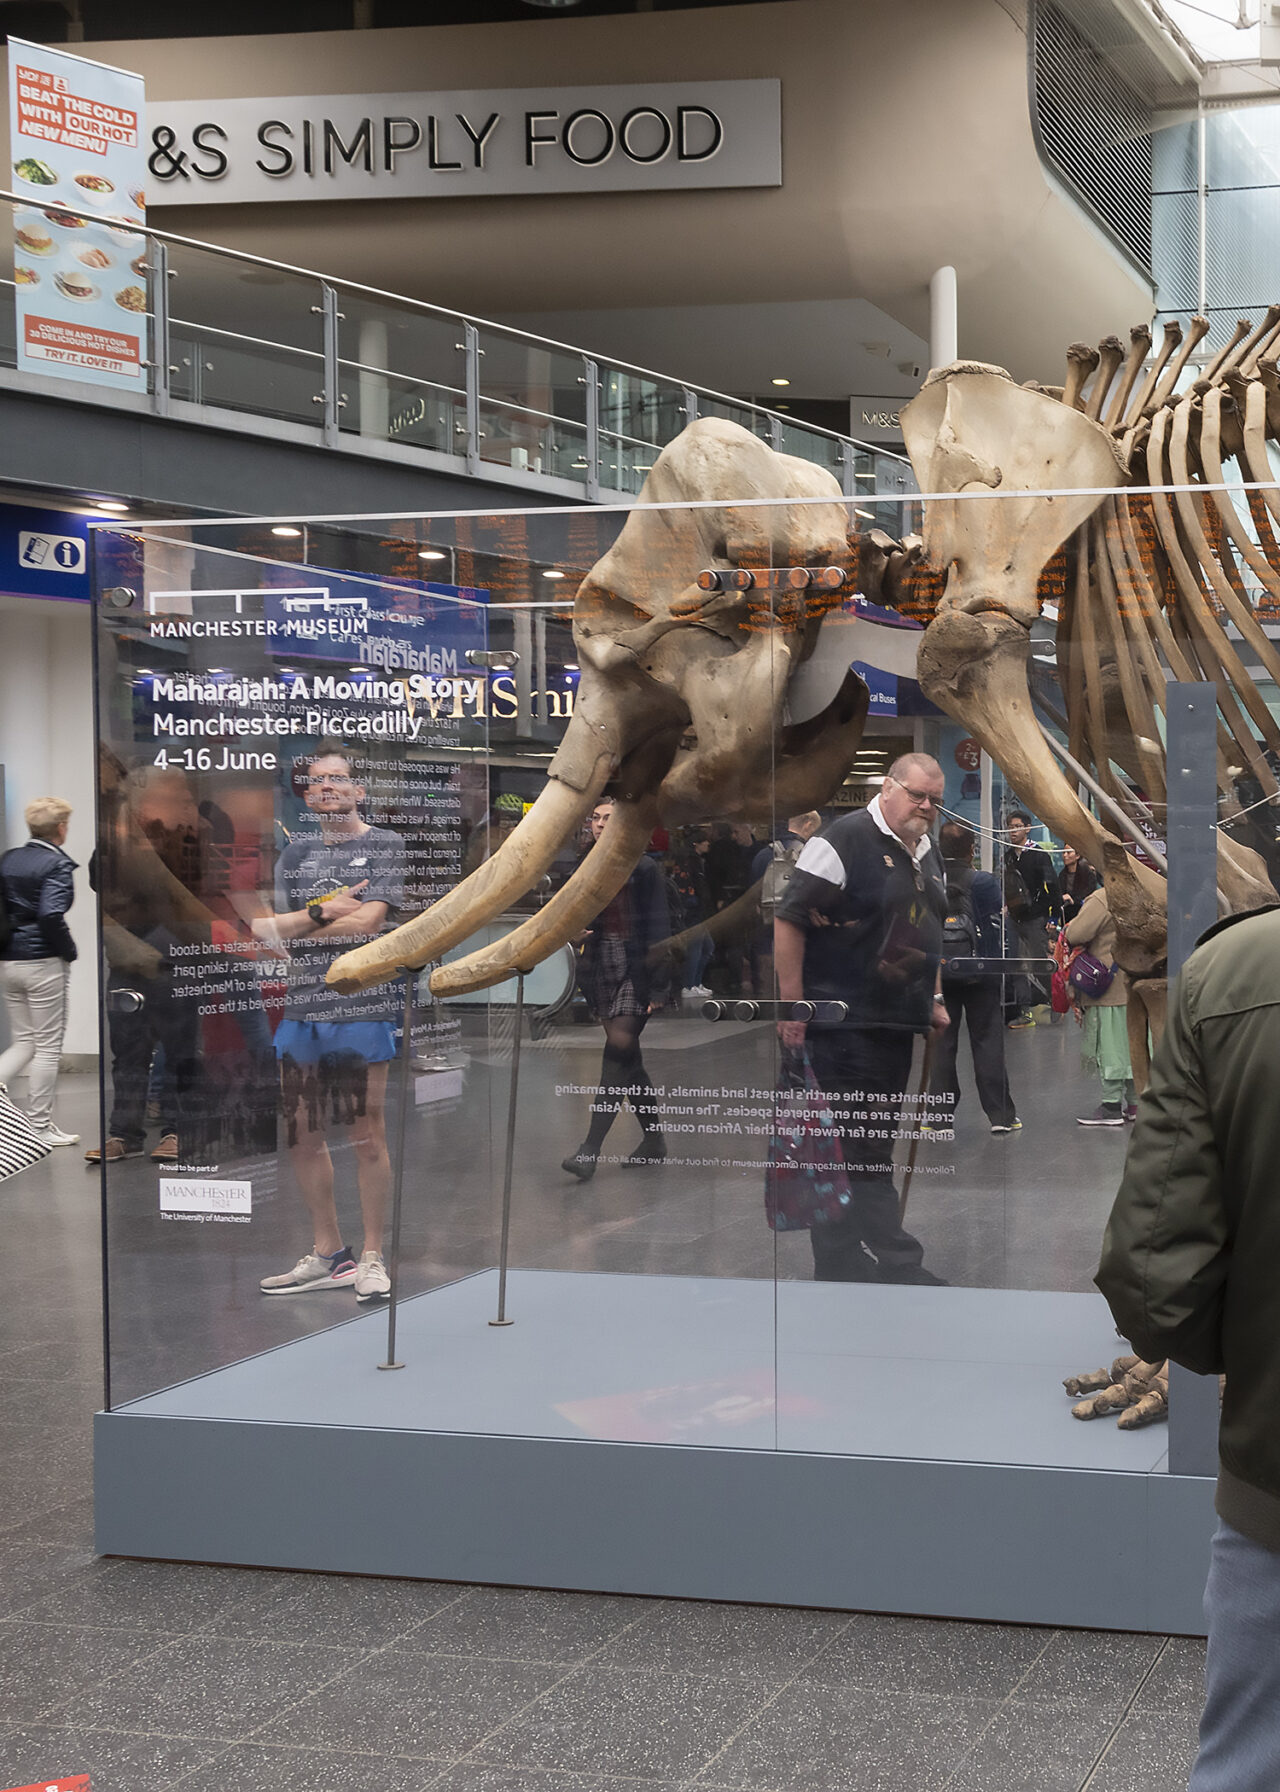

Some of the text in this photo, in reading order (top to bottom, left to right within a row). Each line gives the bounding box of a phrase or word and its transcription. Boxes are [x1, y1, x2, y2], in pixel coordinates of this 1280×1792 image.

[20, 84, 135, 126] BEAT THE COLD
[19, 101, 133, 143] WITH OUR HOT
[21, 119, 106, 153] NEW MENU
[149, 105, 724, 181] &S SIMPLY FOOD
[39, 324, 65, 335] COME
[75, 331, 93, 341] AND
[93, 334, 110, 344] TRY
[109, 337, 127, 348] OUR
[41, 331, 87, 347] DELICIOUS
[88, 340, 105, 350] HOT
[44, 348, 67, 360] TRY
[80, 355, 108, 368] LOVE
[150, 618, 368, 638] MANCHESTER MUSEUM
[152, 674, 479, 706] Maharajah: A Moving Story
[879, 692, 897, 704] Buses
[153, 710, 424, 739] Manchester Piccadilly
[216, 747, 277, 770] June
[196, 1165, 210, 1173] part
[166, 1186, 247, 1199] MANCHESTER
[173, 1213, 205, 1223] University
[206, 1214, 214, 1222] of
[214, 1215, 251, 1223] Manchester
